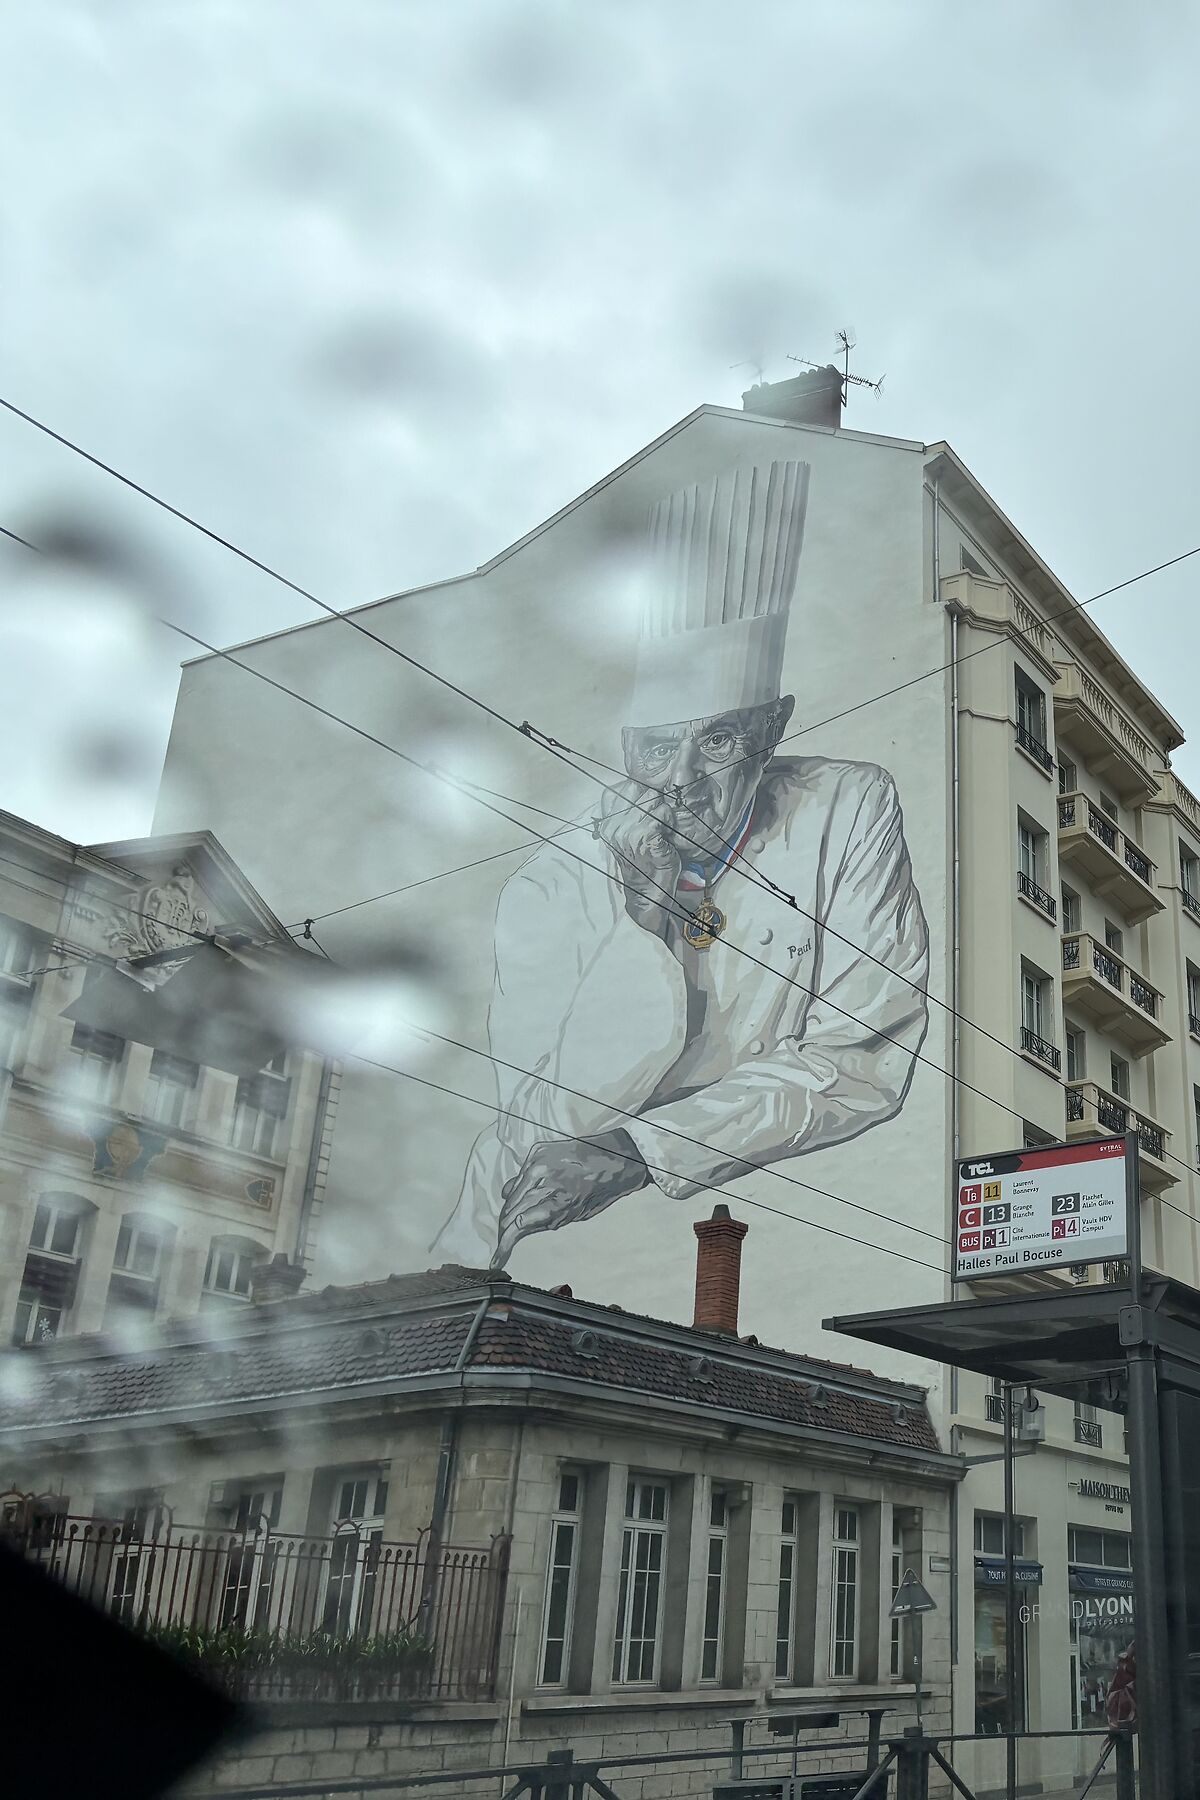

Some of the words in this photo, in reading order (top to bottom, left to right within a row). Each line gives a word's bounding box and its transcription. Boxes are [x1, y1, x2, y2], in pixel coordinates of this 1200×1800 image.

[787, 938, 812, 959] Paul
[968, 1162, 994, 1176] TCL
[1012, 1180, 1034, 1188] Laurent
[984, 1184, 1000, 1199] 11
[1012, 1187, 1040, 1196] Bonnevay
[1082, 1193, 1103, 1201] Flachet
[1012, 1204, 1033, 1213] Grange
[1056, 1196, 1075, 1212] 23
[1082, 1201, 1097, 1209] Alain
[1098, 1199, 1114, 1207] Gilles
[965, 1211, 975, 1225] C
[988, 1206, 1006, 1222] 13
[1012, 1211, 1035, 1219] Blanche
[1099, 1215, 1113, 1223] HDV
[1012, 1226, 1024, 1234] Cité
[1082, 1225, 1104, 1233] Campus
[1012, 1231, 1050, 1241] Internationale
[961, 1236, 979, 1248] BUS
[958, 1257, 991, 1271] Halles
[995, 1252, 1019, 1266] Paul
[1023, 1248, 1063, 1262] Bocuse
[988, 1570, 1001, 1580] TOUT
[1020, 1571, 1039, 1580] CUISINE
